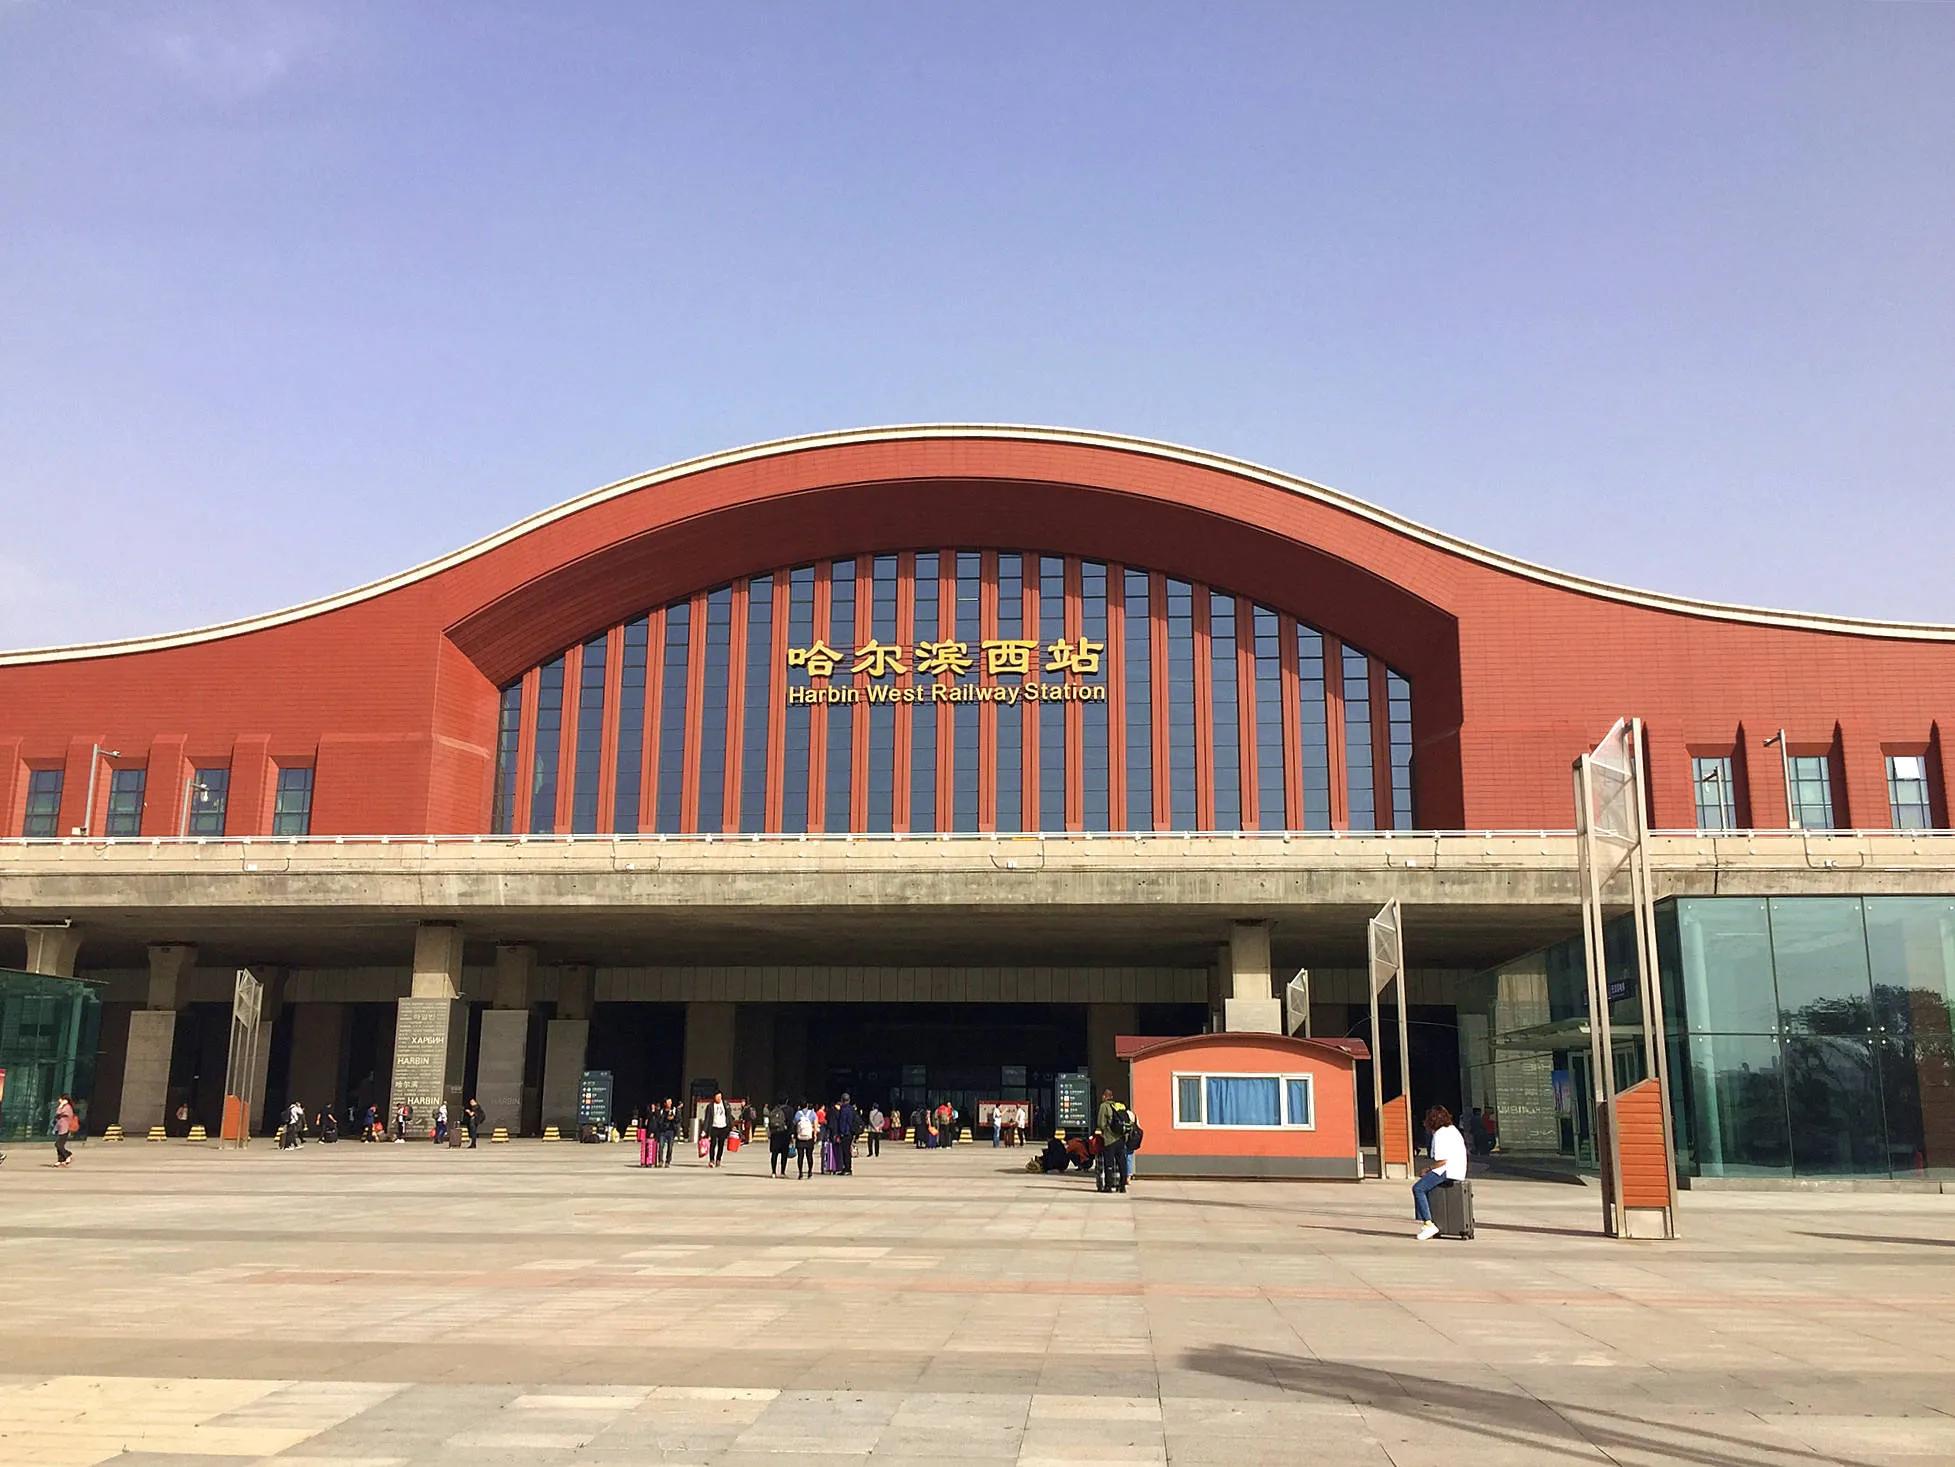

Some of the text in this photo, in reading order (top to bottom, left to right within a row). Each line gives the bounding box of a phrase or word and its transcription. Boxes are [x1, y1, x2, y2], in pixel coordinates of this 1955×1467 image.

[787, 637, 1104, 677] 哈尔滨西站
[789, 683, 1105, 705] Harbin West Railway Station
[411, 1036, 445, 1044] ХАРБИН
[397, 1056, 430, 1065] HARBIN
[407, 1096, 440, 1105] HARBIN
